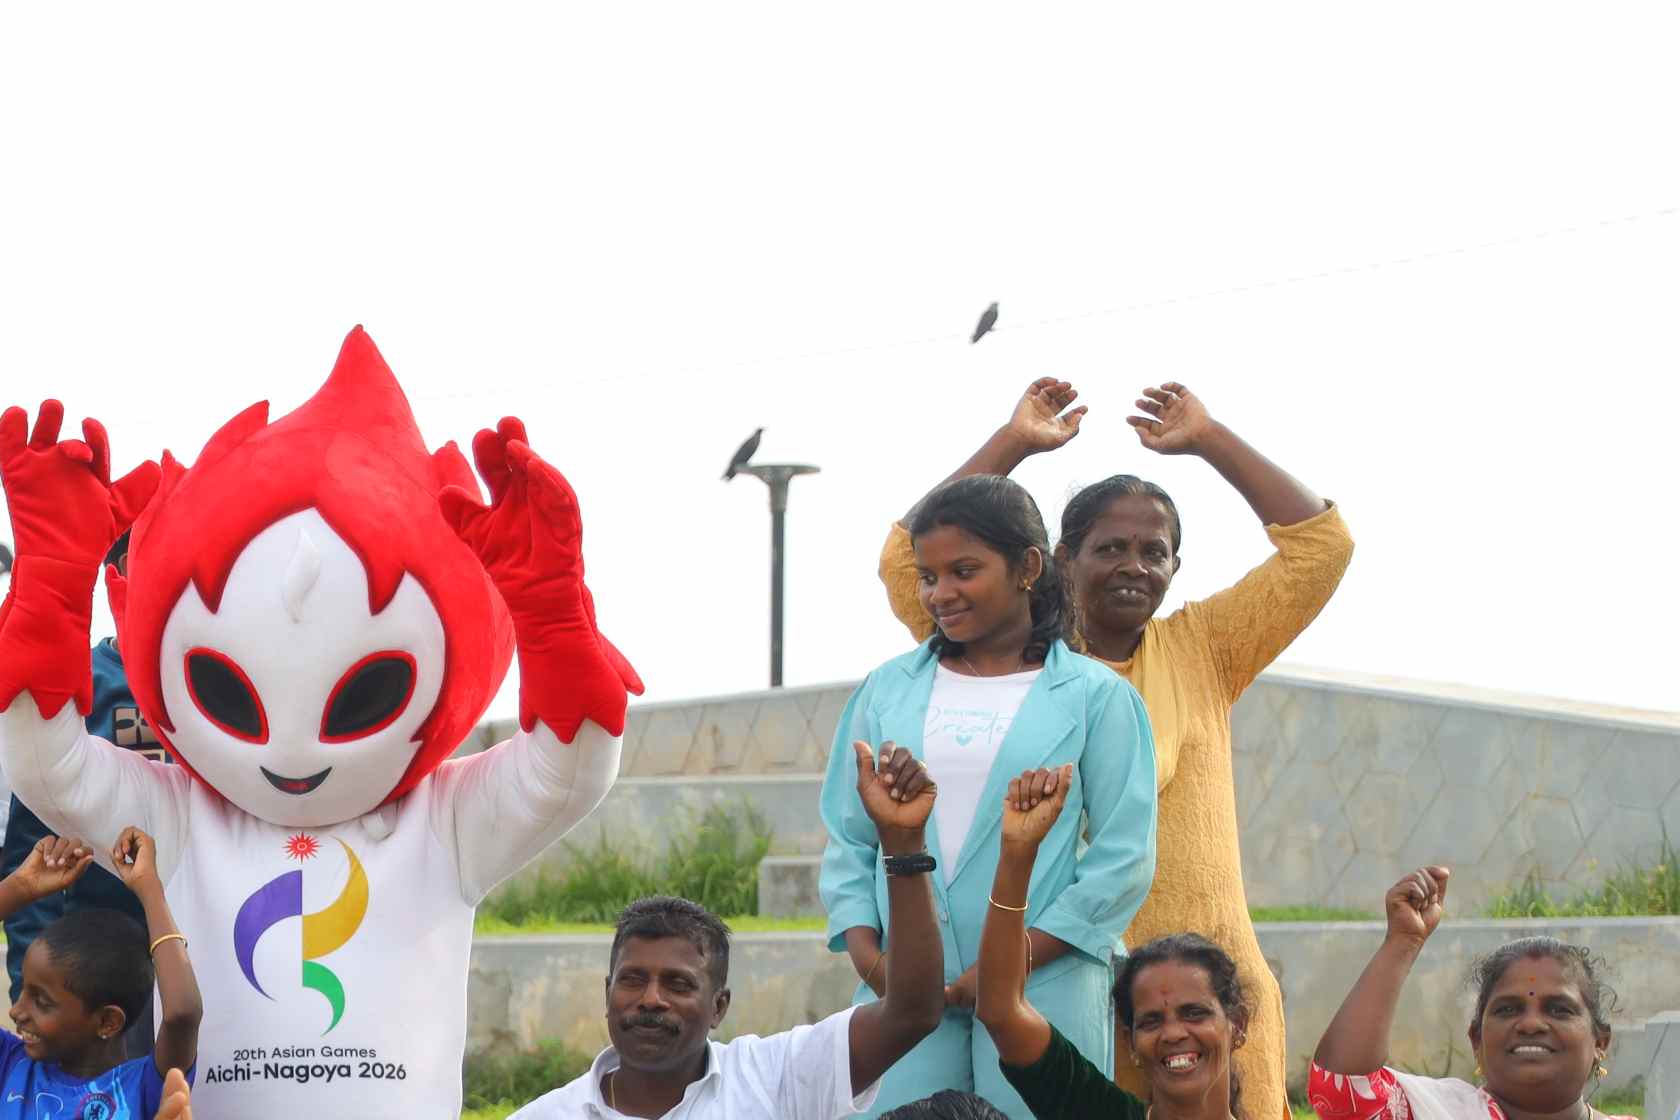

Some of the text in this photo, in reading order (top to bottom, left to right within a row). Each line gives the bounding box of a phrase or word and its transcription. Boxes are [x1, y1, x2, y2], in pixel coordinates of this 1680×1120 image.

[234, 1045, 377, 1061] 20th Asian Games
[205, 1061, 407, 1084] Aichi-Nagoya 2026
